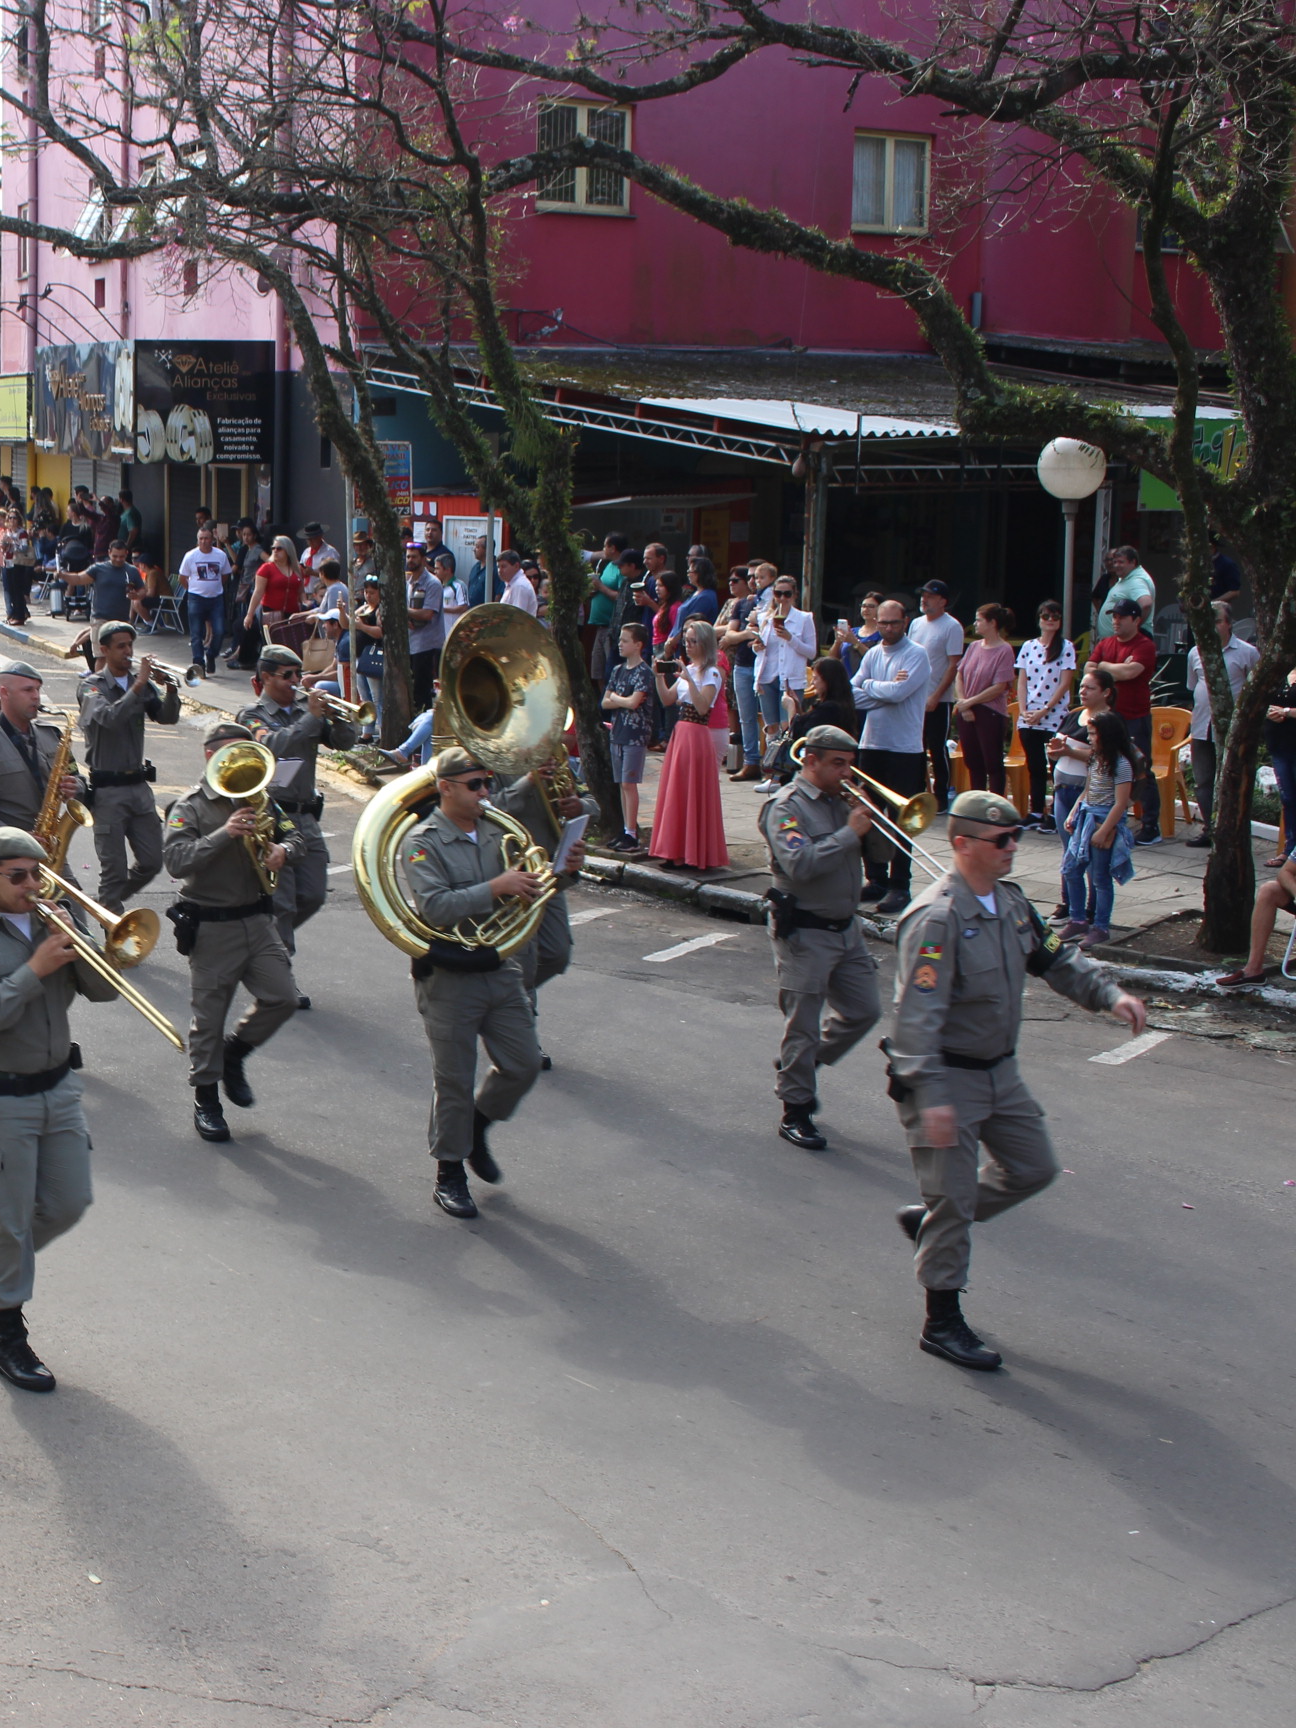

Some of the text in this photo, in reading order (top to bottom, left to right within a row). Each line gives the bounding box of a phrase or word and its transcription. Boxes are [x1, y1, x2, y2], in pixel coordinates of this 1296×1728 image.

[193, 357, 239, 375] Ateliê
[172, 374, 238, 391] Alianças
[206, 391, 257, 401] Exclusivas
[217, 417, 253, 425] Fabricação
[217, 426, 246, 434] alianças
